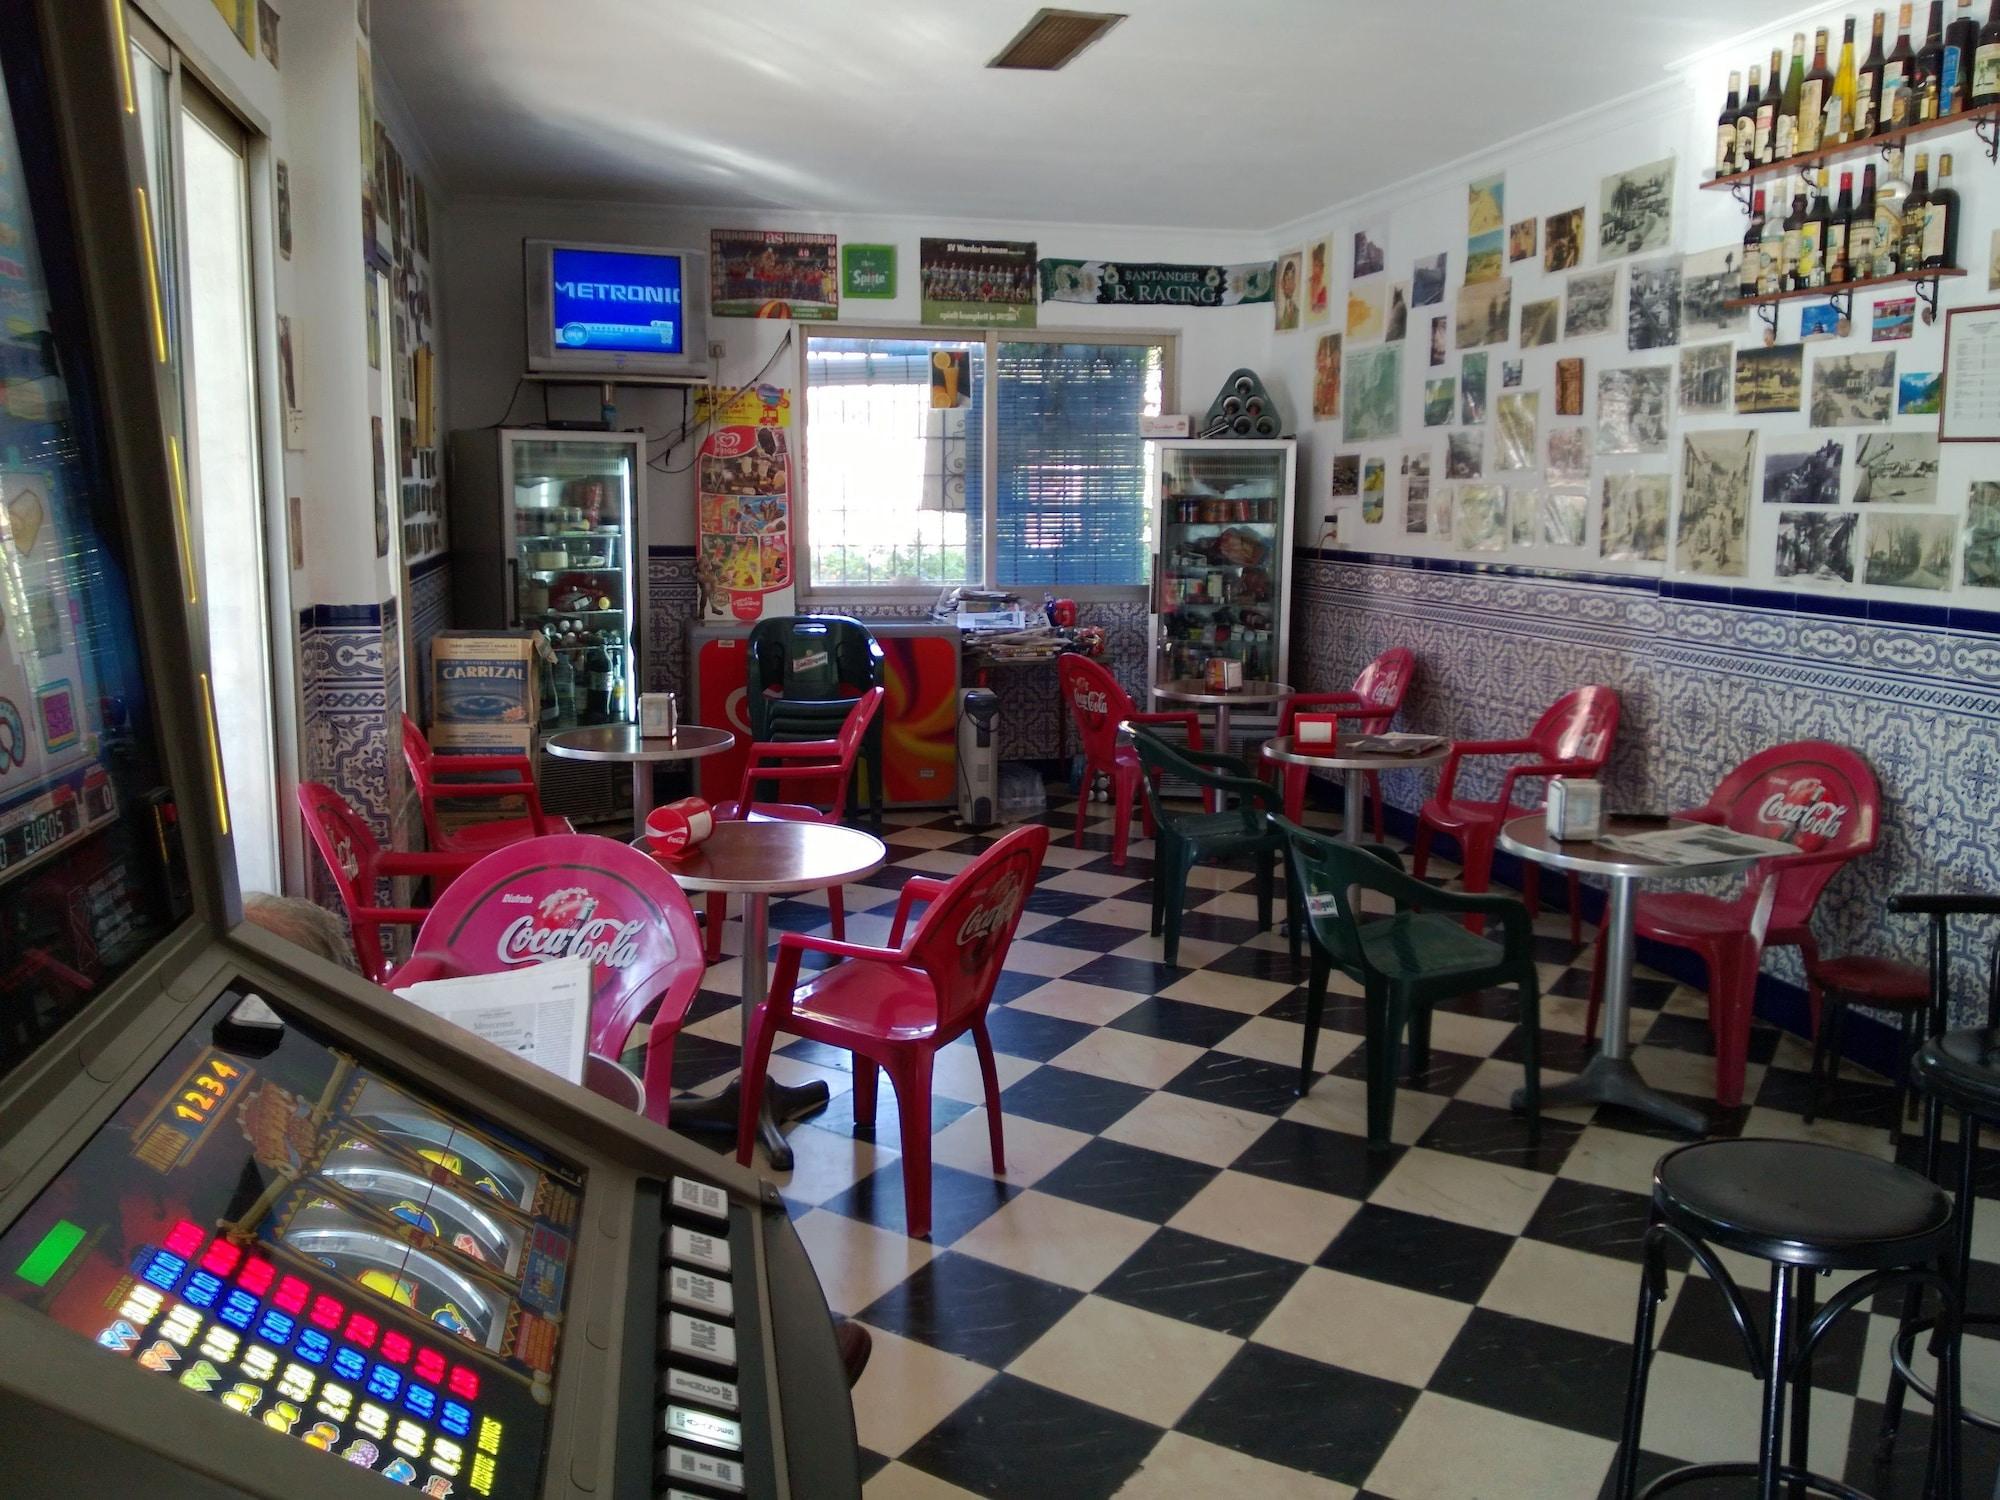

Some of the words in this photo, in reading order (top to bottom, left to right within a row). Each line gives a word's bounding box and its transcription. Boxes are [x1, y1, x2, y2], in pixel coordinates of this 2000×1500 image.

[765, 232, 784, 244] as
[1124, 270, 1199, 282] SANTANDER
[1139, 285, 1216, 303] RACING
[442, 666, 526, 681] CARRIZAL
[175, 1060, 239, 1123] 1234
[219, 1289, 260, 1329] 16,00
